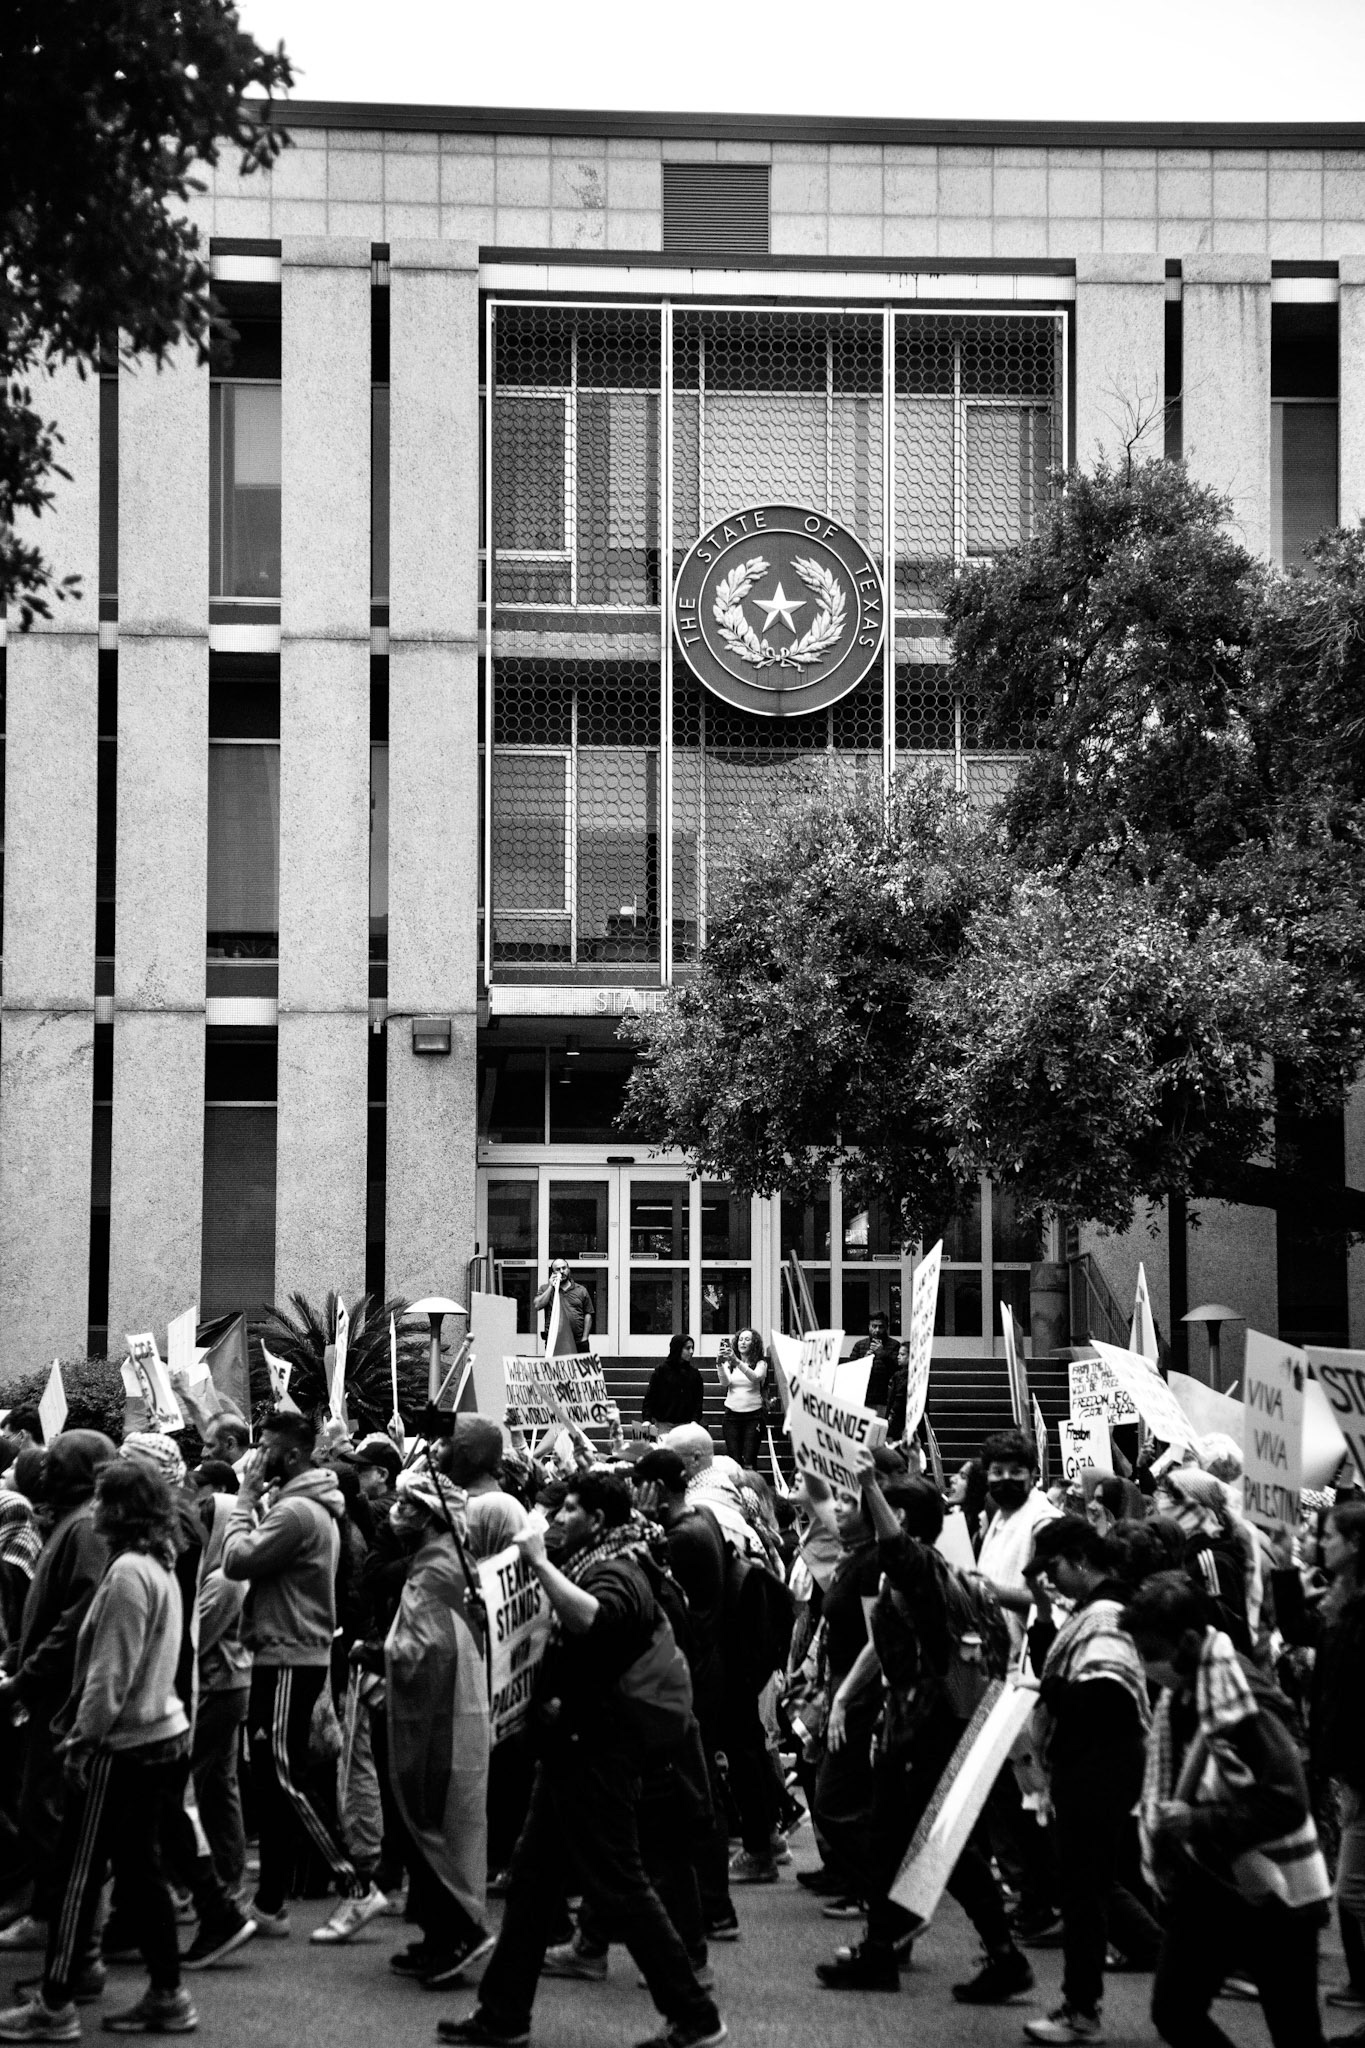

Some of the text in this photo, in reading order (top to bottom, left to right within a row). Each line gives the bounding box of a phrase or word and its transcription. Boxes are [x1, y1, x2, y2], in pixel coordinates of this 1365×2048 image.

[679, 511, 880, 649] THE STATE OF TEXAS
[540, 1360, 570, 1381] POWER
[567, 1359, 578, 1379] OF
[580, 1379, 608, 1402] POWER
[1115, 1390, 1132, 1403] FO
[1249, 1377, 1284, 1421] VIVA
[520, 1406, 549, 1425] WORLD
[566, 1405, 590, 1423] KNOW
[802, 1391, 870, 1443] MEXICANOS
[816, 1428, 844, 1459] CON
[1254, 1428, 1288, 1470] VIVA
[496, 1583, 541, 1643] STANDS
